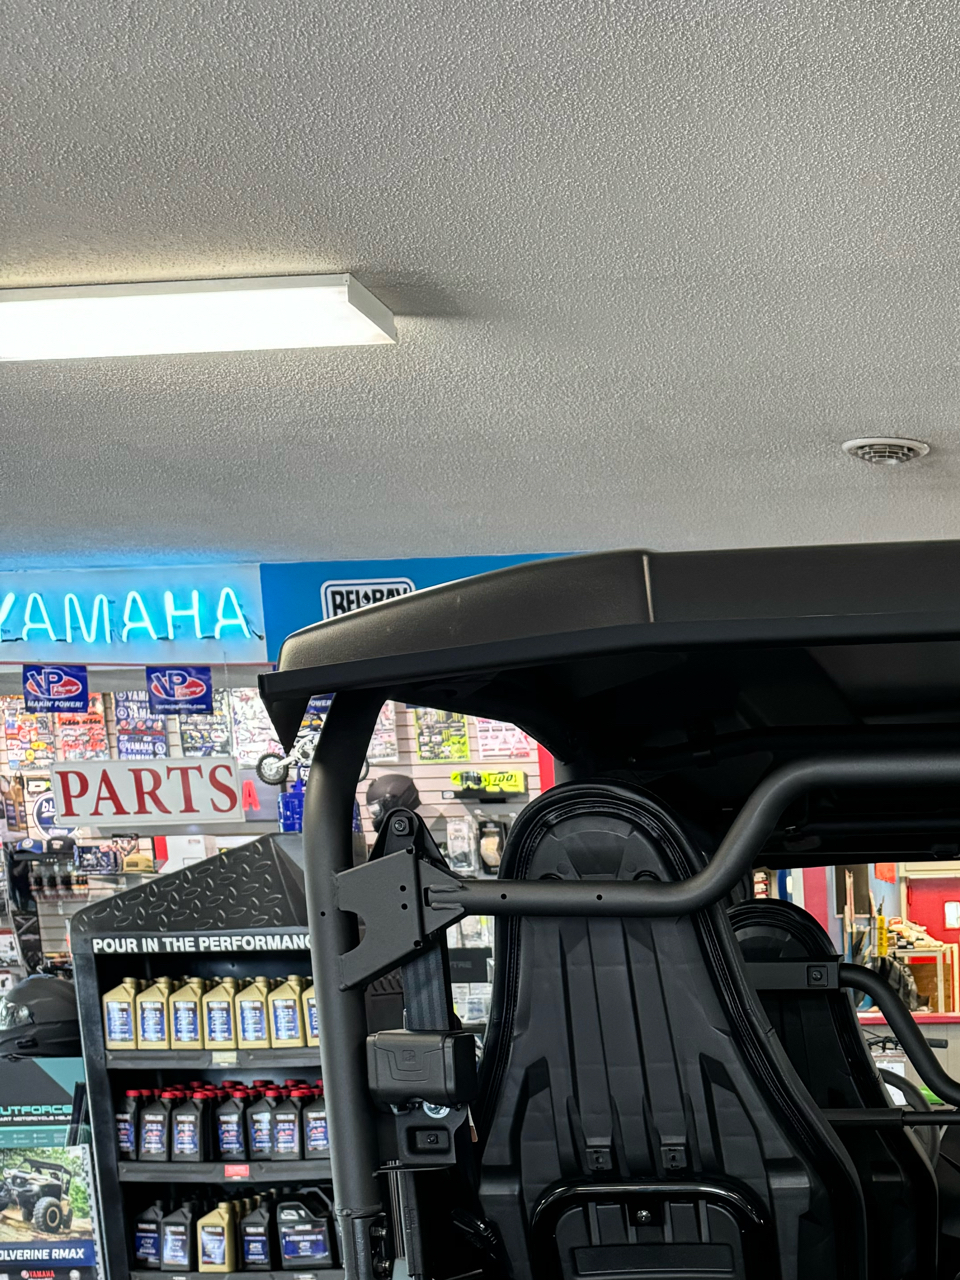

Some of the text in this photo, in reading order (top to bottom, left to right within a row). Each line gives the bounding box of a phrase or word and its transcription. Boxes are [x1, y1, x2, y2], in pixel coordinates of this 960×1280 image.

[55, 764, 239, 817] PARTS
[92, 938, 138, 954] POUR
[142, 938, 159, 952] IN
[162, 937, 196, 951] THE
[0, 1104, 73, 1115] UTFORCE
[0, 1248, 85, 1260] OLVERINE RMAX
[29, 1270, 55, 1278] YAMAHA
